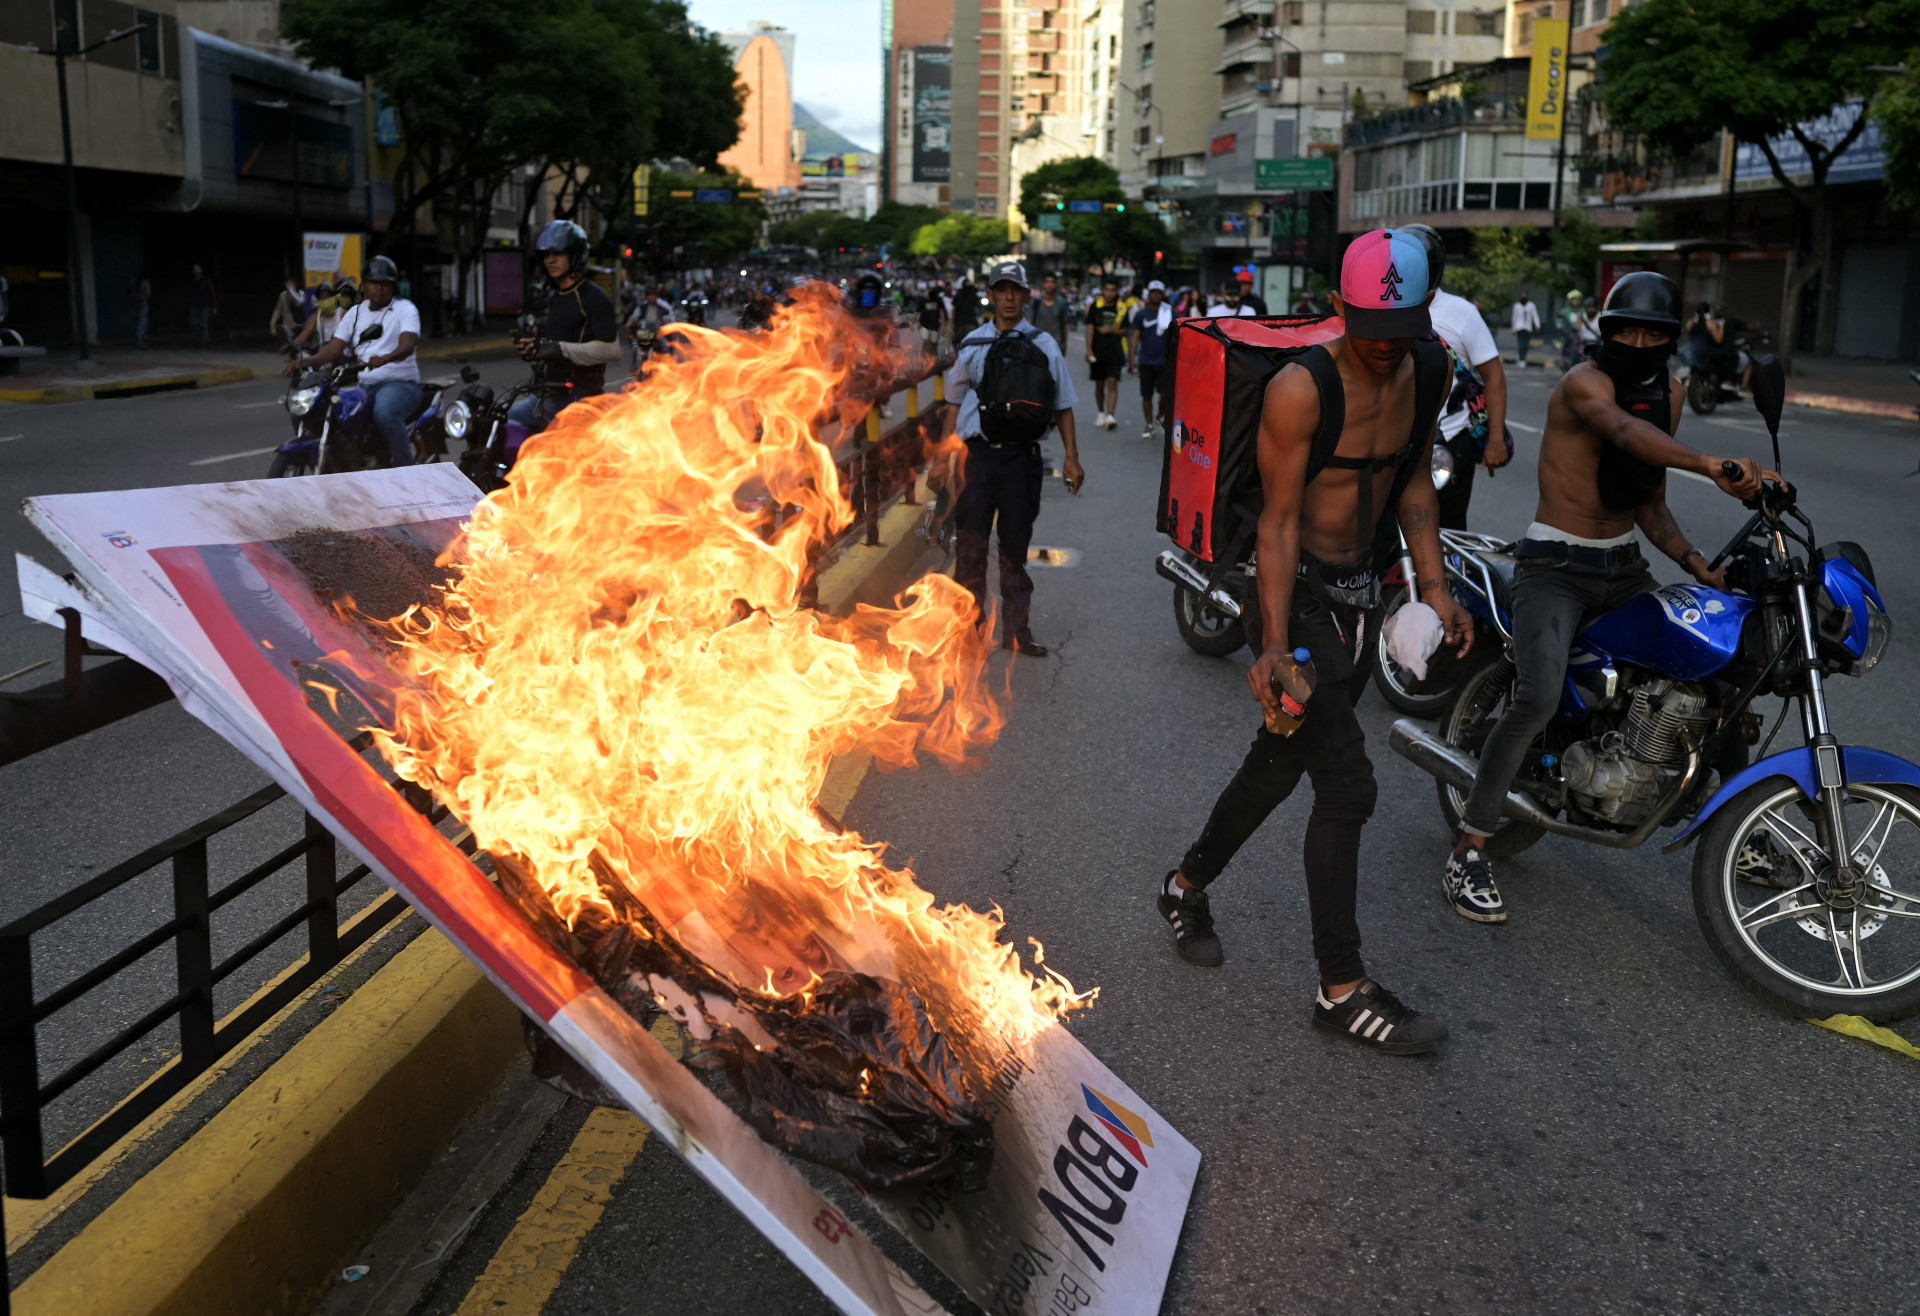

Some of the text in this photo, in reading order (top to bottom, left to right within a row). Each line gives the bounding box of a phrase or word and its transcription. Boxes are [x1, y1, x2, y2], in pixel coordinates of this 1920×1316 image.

[1540, 46, 1562, 114] Decore
[1190, 446, 1211, 468] One
[1191, 428, 1204, 447] De
[1038, 1115, 1139, 1272] BDV
